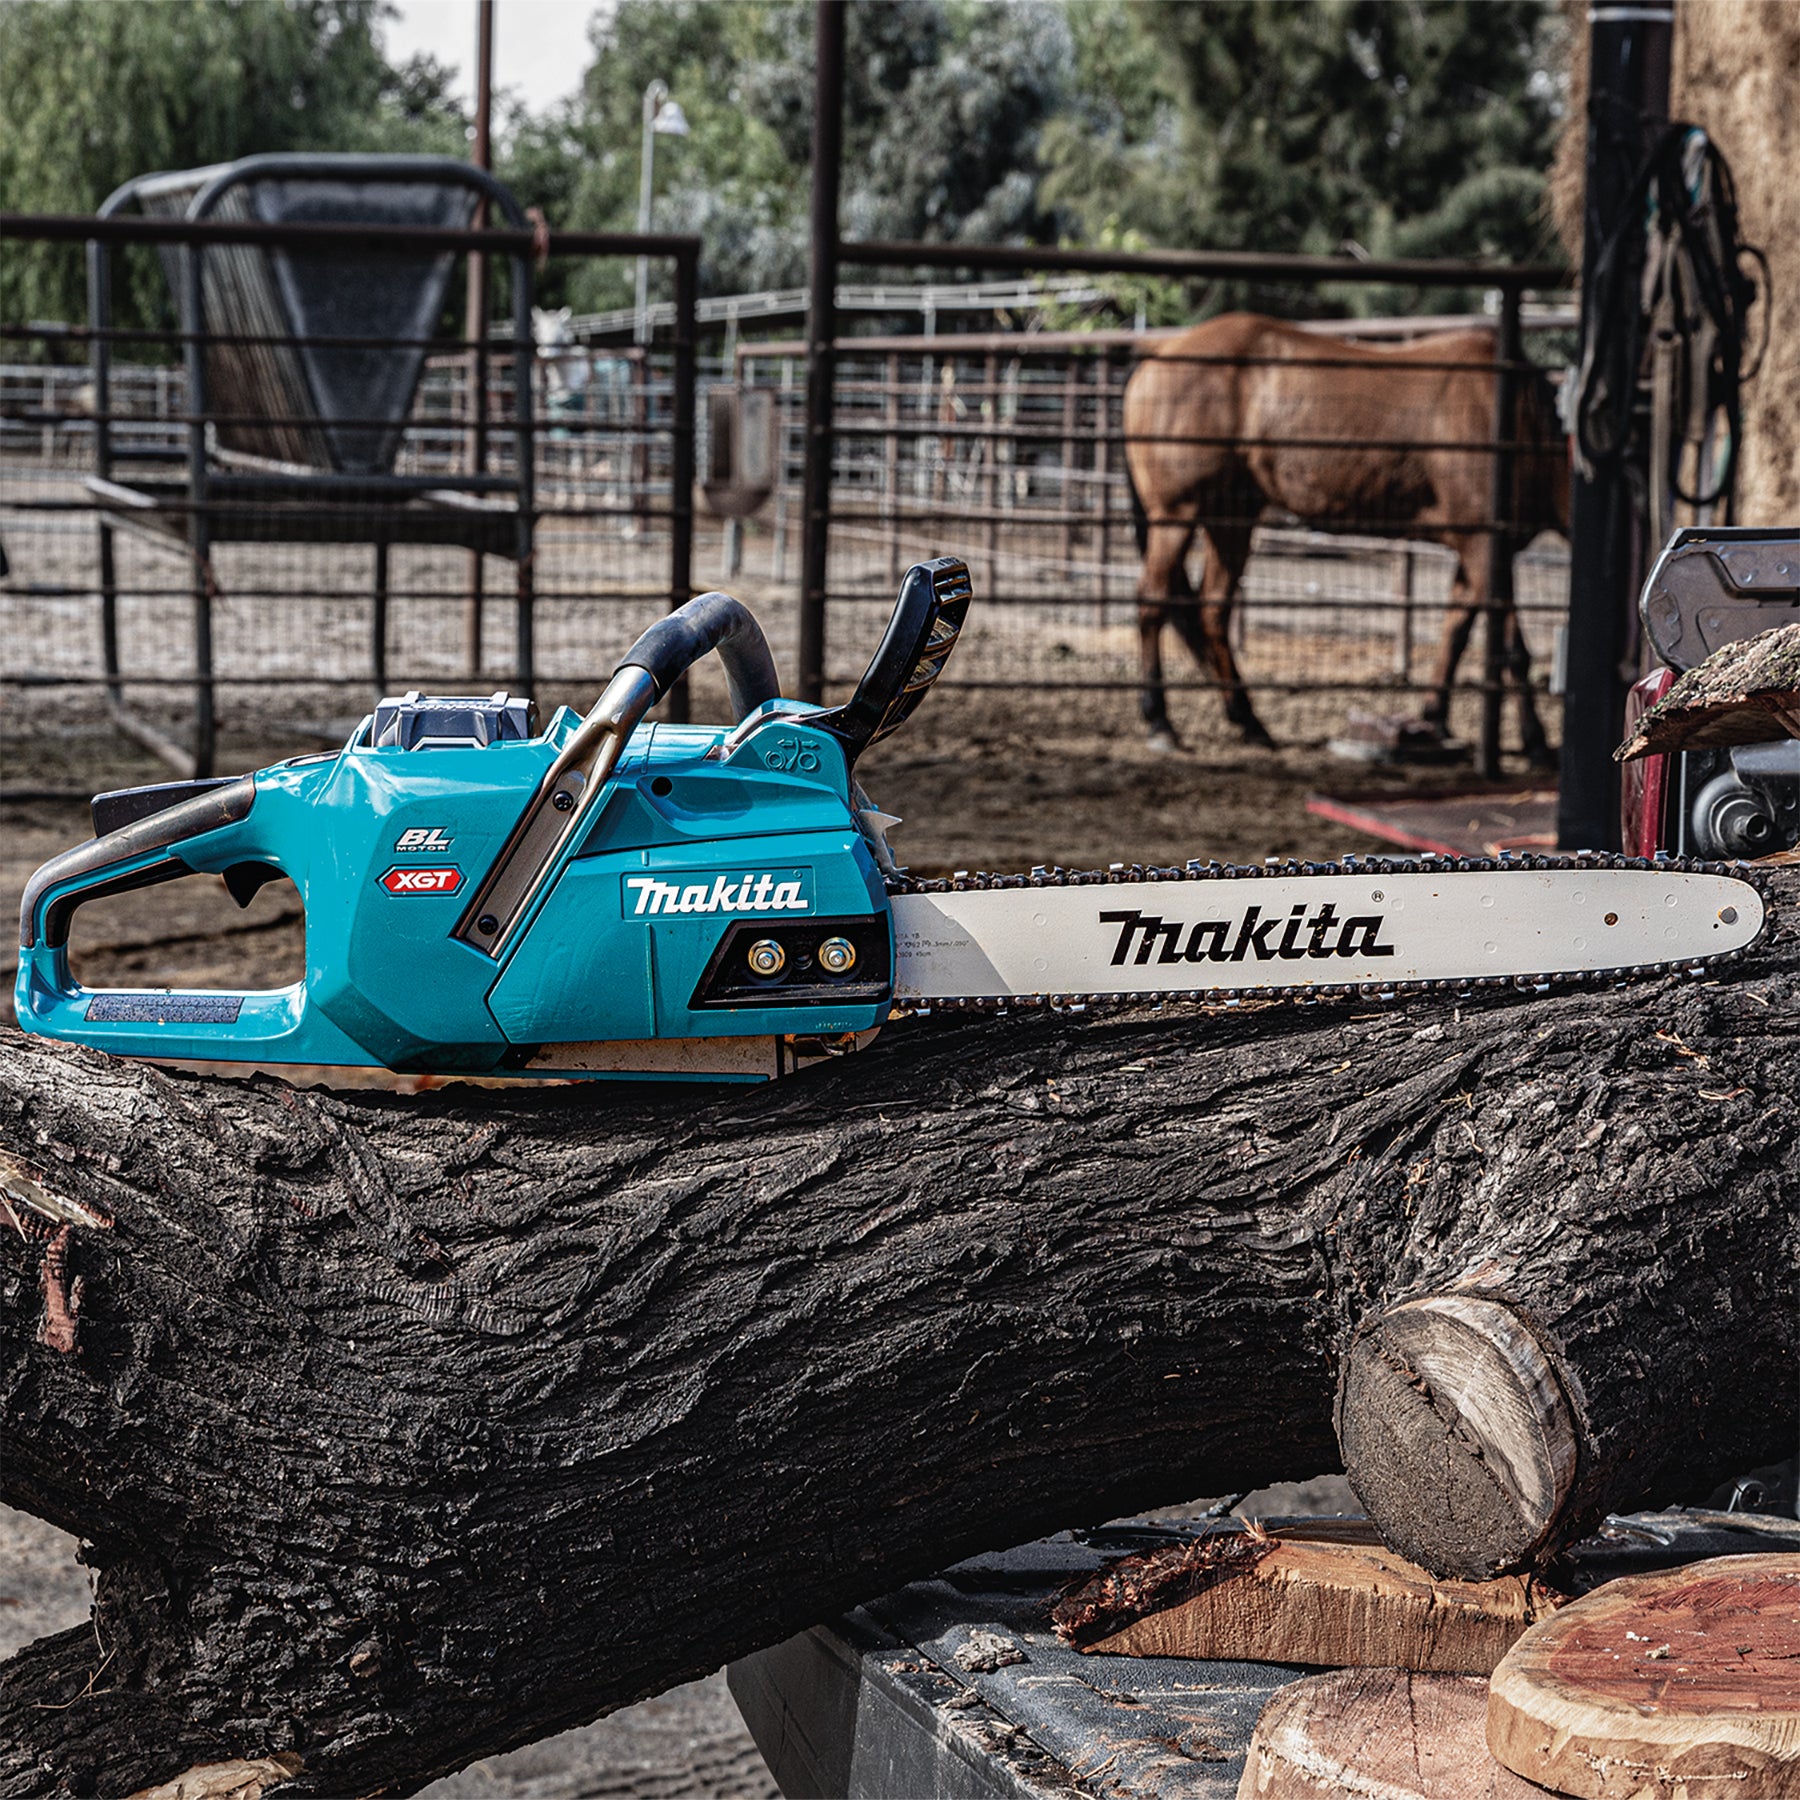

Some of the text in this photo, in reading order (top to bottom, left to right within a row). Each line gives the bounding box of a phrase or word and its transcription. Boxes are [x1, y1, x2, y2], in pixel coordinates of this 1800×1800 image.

[397, 829, 450, 846] BL
[393, 871, 453, 890] XGT
[627, 874, 808, 914] Makita
[1099, 902, 1395, 966] Makita
